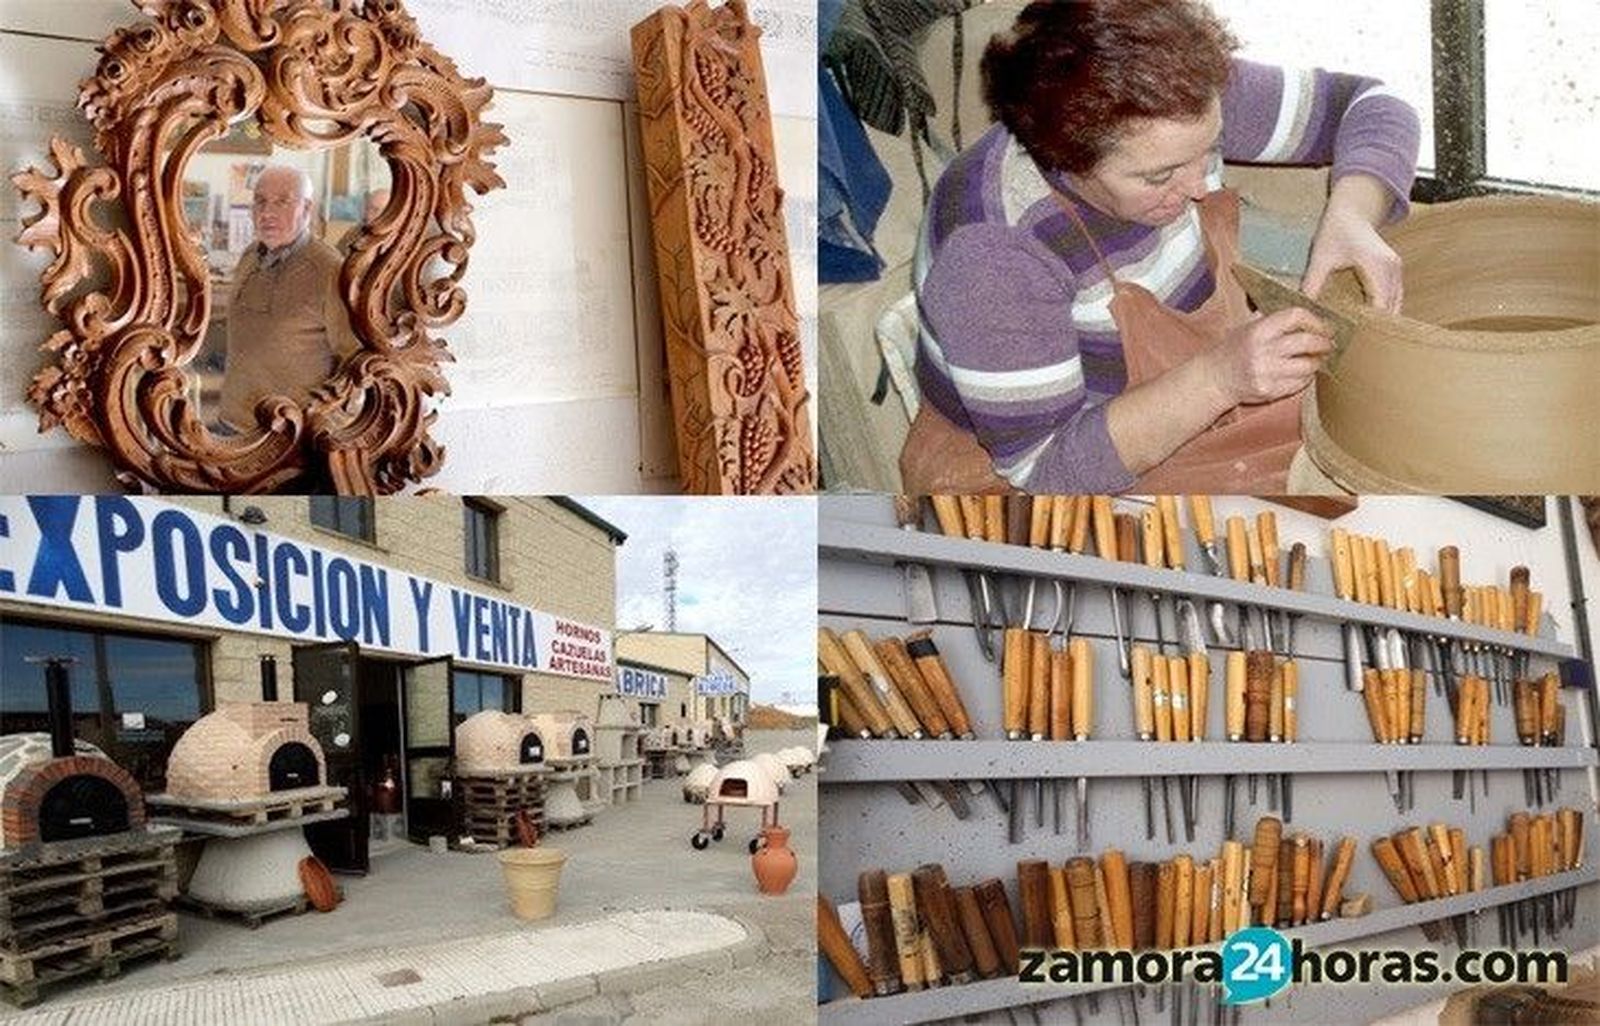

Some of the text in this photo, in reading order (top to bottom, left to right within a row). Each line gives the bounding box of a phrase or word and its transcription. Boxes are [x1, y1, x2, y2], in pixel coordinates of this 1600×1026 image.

[409, 577, 434, 653] Y
[451, 589, 538, 668] VENTA
[556, 620, 601, 644] HORNOS
[551, 639, 606, 662] CAZUELAS
[549, 655, 611, 678] ARTESANAS
[616, 668, 666, 697] BRICA
